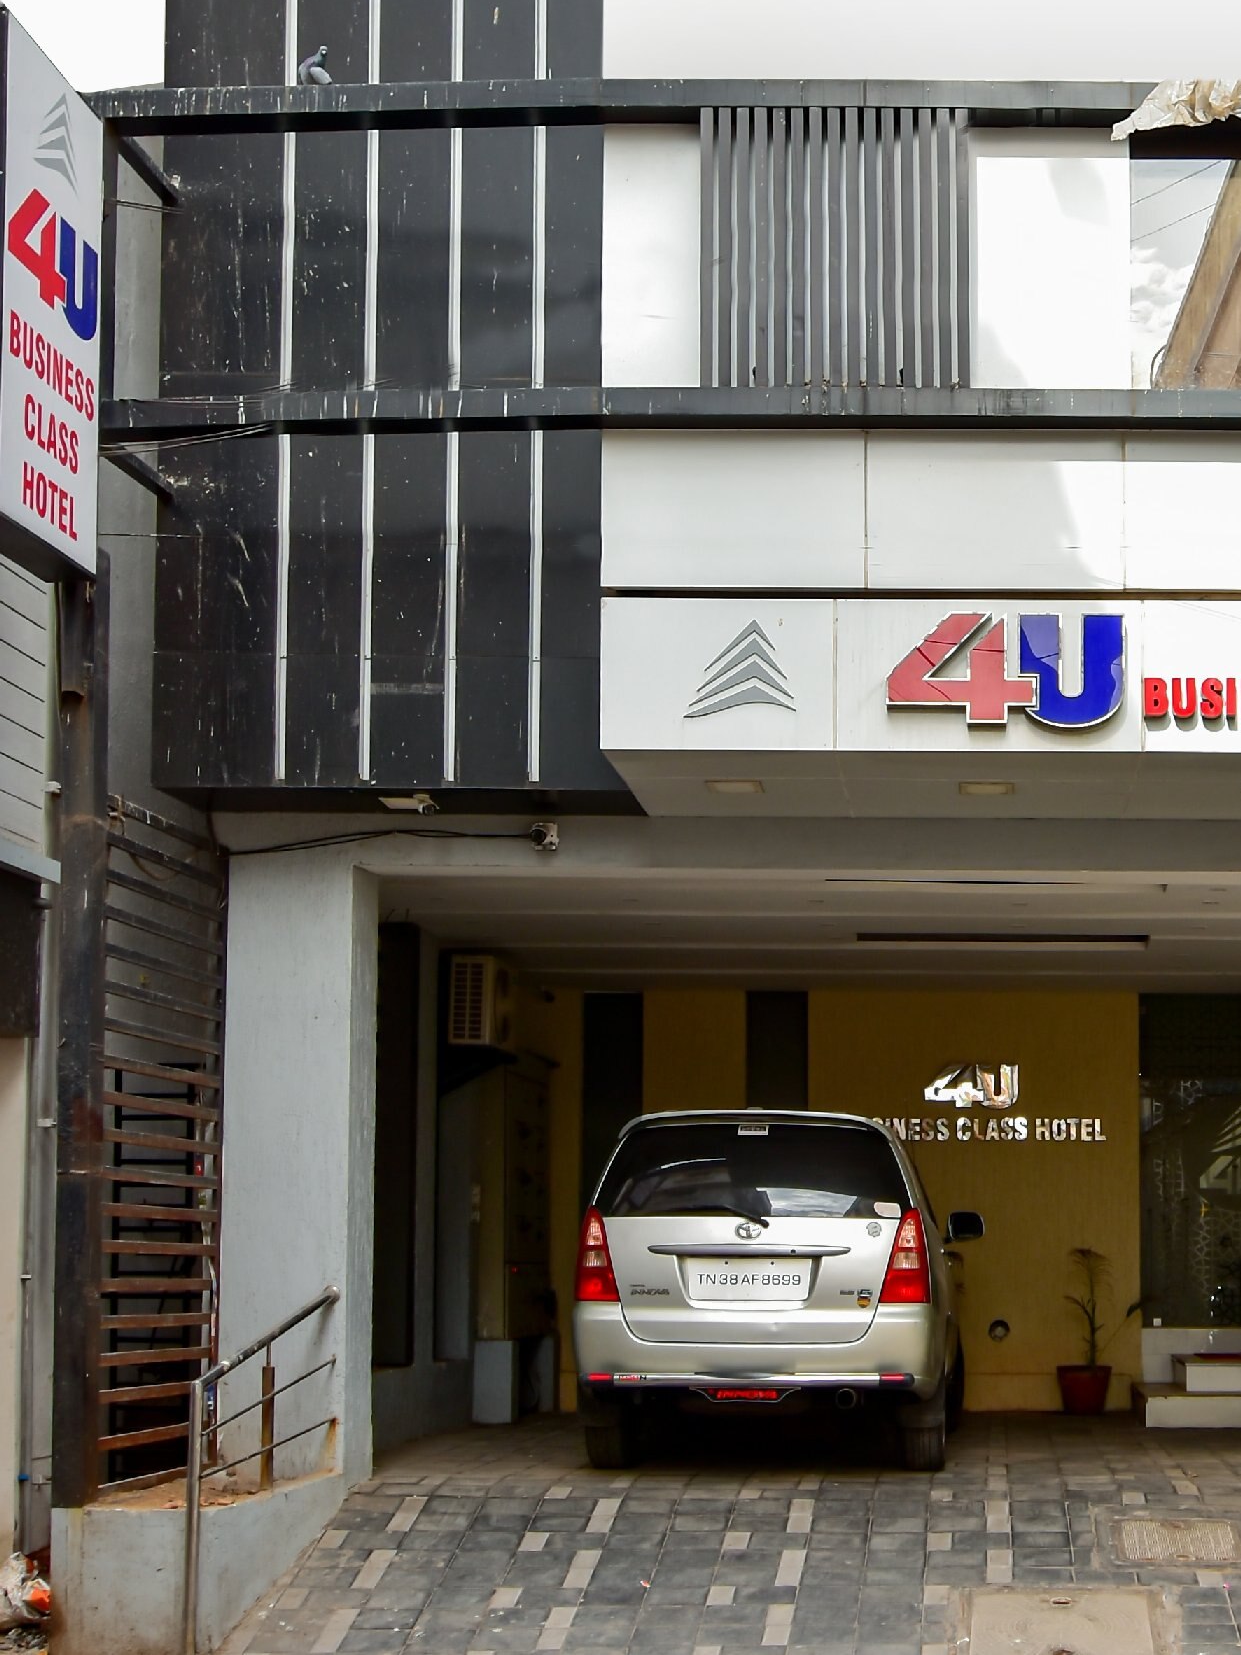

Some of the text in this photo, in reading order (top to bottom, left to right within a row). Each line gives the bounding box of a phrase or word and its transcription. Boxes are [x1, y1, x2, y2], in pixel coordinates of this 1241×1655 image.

[8, 188, 98, 341] 4U
[10, 309, 95, 422] BUSINESS
[24, 393, 79, 475] CLASS
[23, 461, 78, 542] HOTEL
[885, 611, 1126, 730] 4U
[923, 1064, 1019, 1109] 4U
[872, 1117, 1107, 1142] NESS CLASS HOTEL
